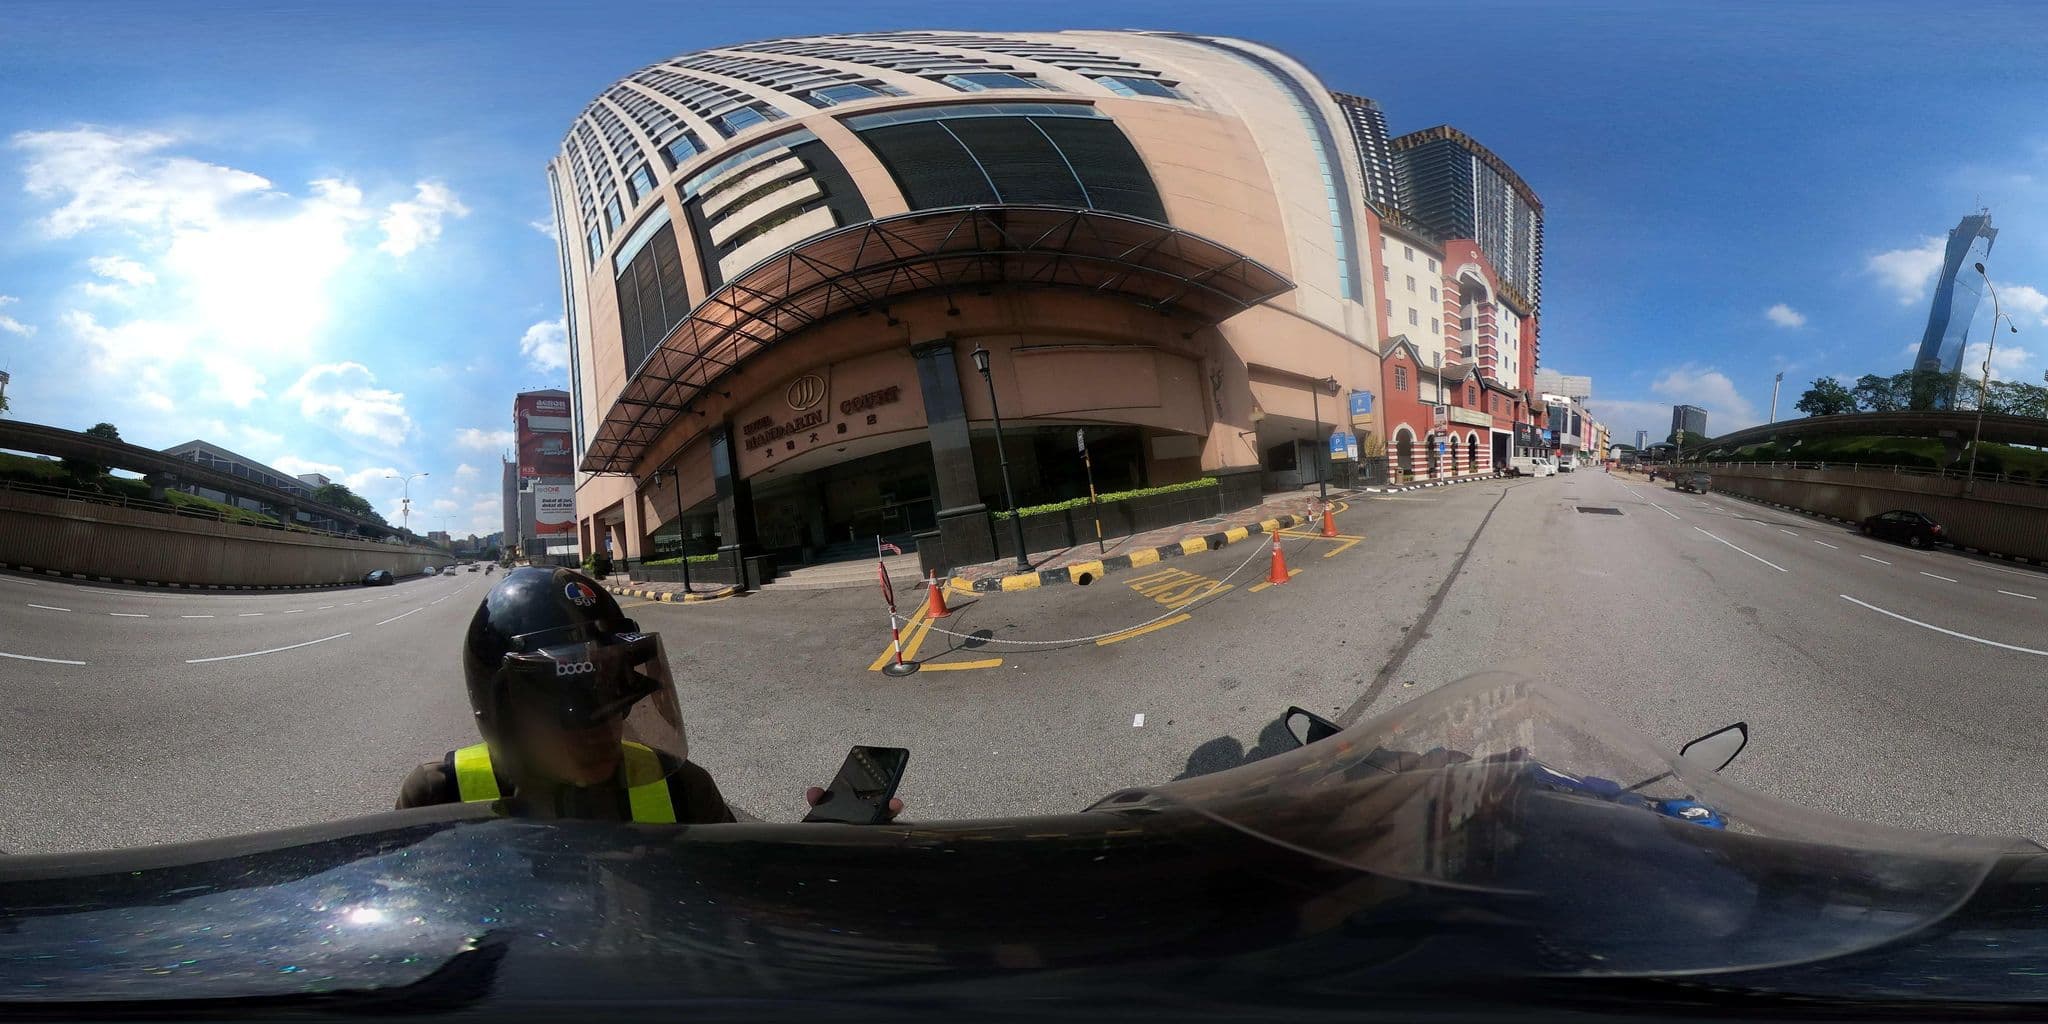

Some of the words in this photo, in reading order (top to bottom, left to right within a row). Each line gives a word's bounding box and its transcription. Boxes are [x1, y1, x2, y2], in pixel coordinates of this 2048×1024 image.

[840, 386, 901, 415] COURT
[744, 409, 824, 451] MANDARIN
[1121, 567, 1234, 609] TEKSI
